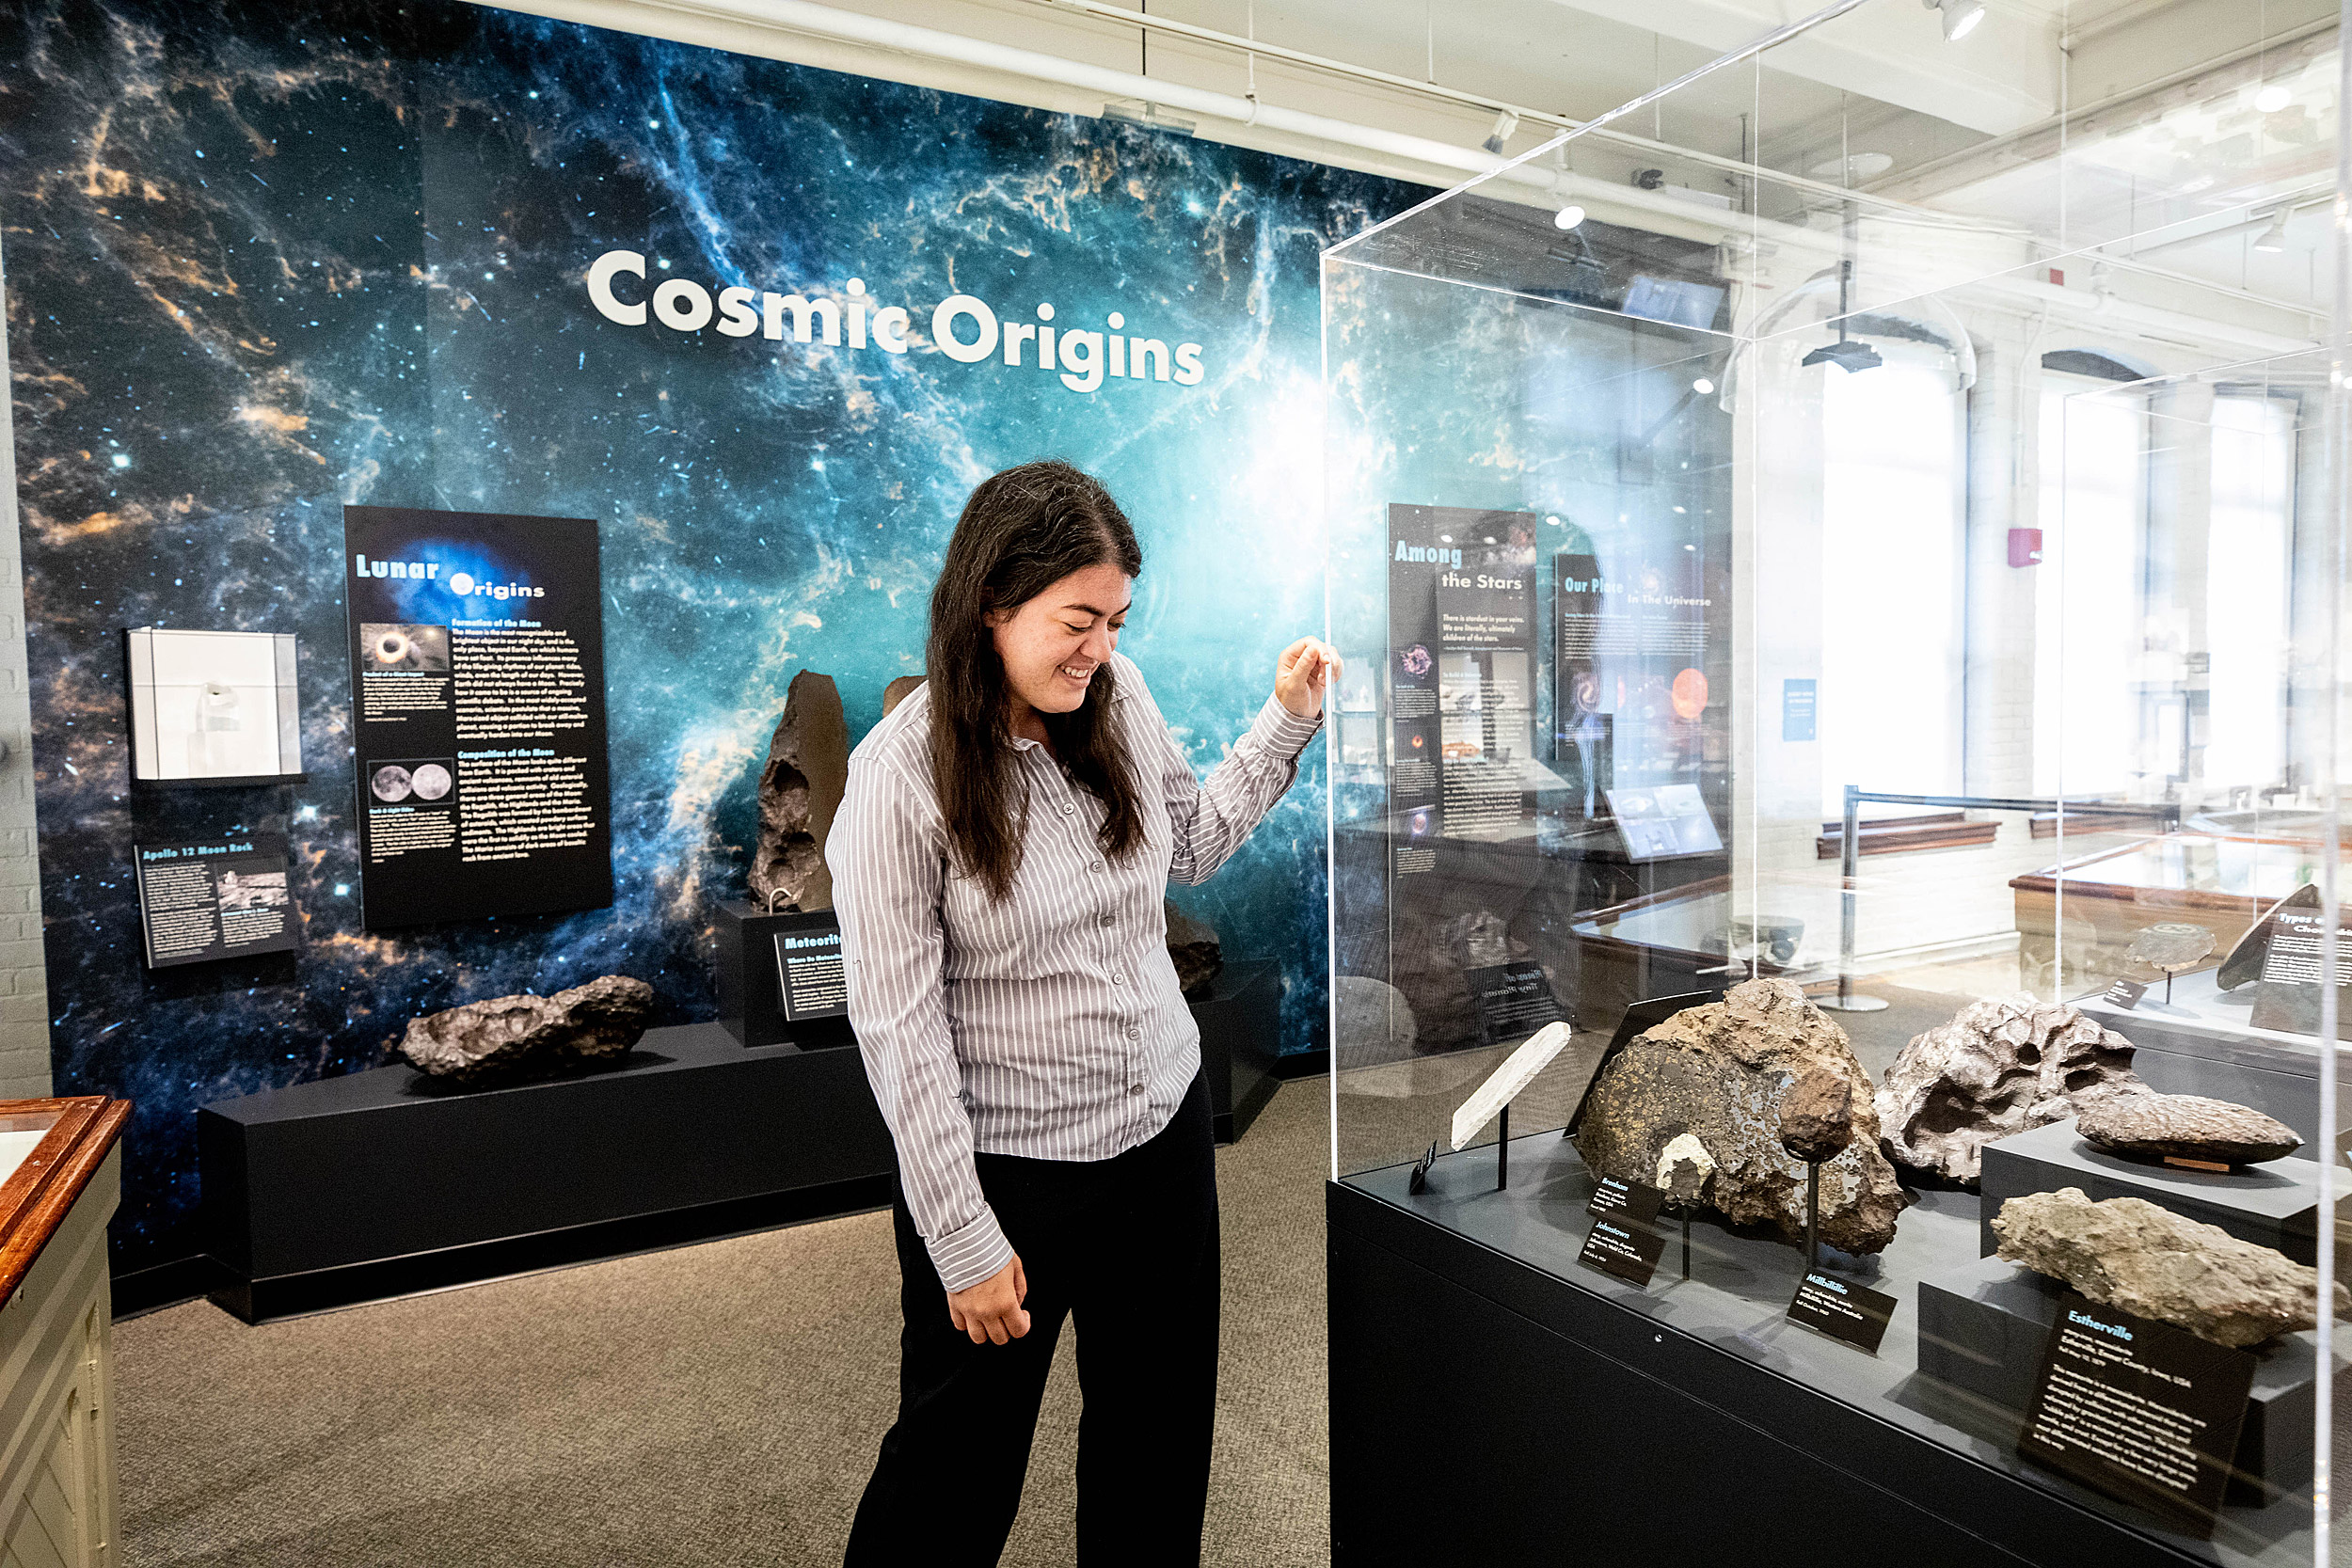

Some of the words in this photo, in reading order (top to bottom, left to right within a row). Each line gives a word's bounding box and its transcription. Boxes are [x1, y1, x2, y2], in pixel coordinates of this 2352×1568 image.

[587, 249, 908, 354] Cosmic
[931, 294, 1204, 393] Origins
[1394, 540, 1462, 570] Among
[357, 554, 439, 579] Lunar
[450, 572, 545, 600] Origins
[1441, 572, 1471, 588] the
[1476, 574, 1522, 590] Stars
[1565, 577, 1588, 593] Our
[1591, 578, 1624, 594] Place
[1628, 594, 1639, 604] In
[1642, 594, 1661, 605] The
[1664, 595, 1711, 607] Universe
[452, 618, 493, 626] Formation
[458, 750, 506, 759] Composition
[508, 749, 516, 757] of
[143, 848, 178, 860] Apollo
[183, 847, 195, 856] 12
[230, 843, 253, 852] Rock
[2280, 913, 2312, 924] Types
[785, 934, 841, 949] Meteorit
[1602, 1178, 1628, 1191] Brenham
[1596, 1222, 1629, 1239] Johnstown
[2069, 1310, 2133, 1340] Estherville
